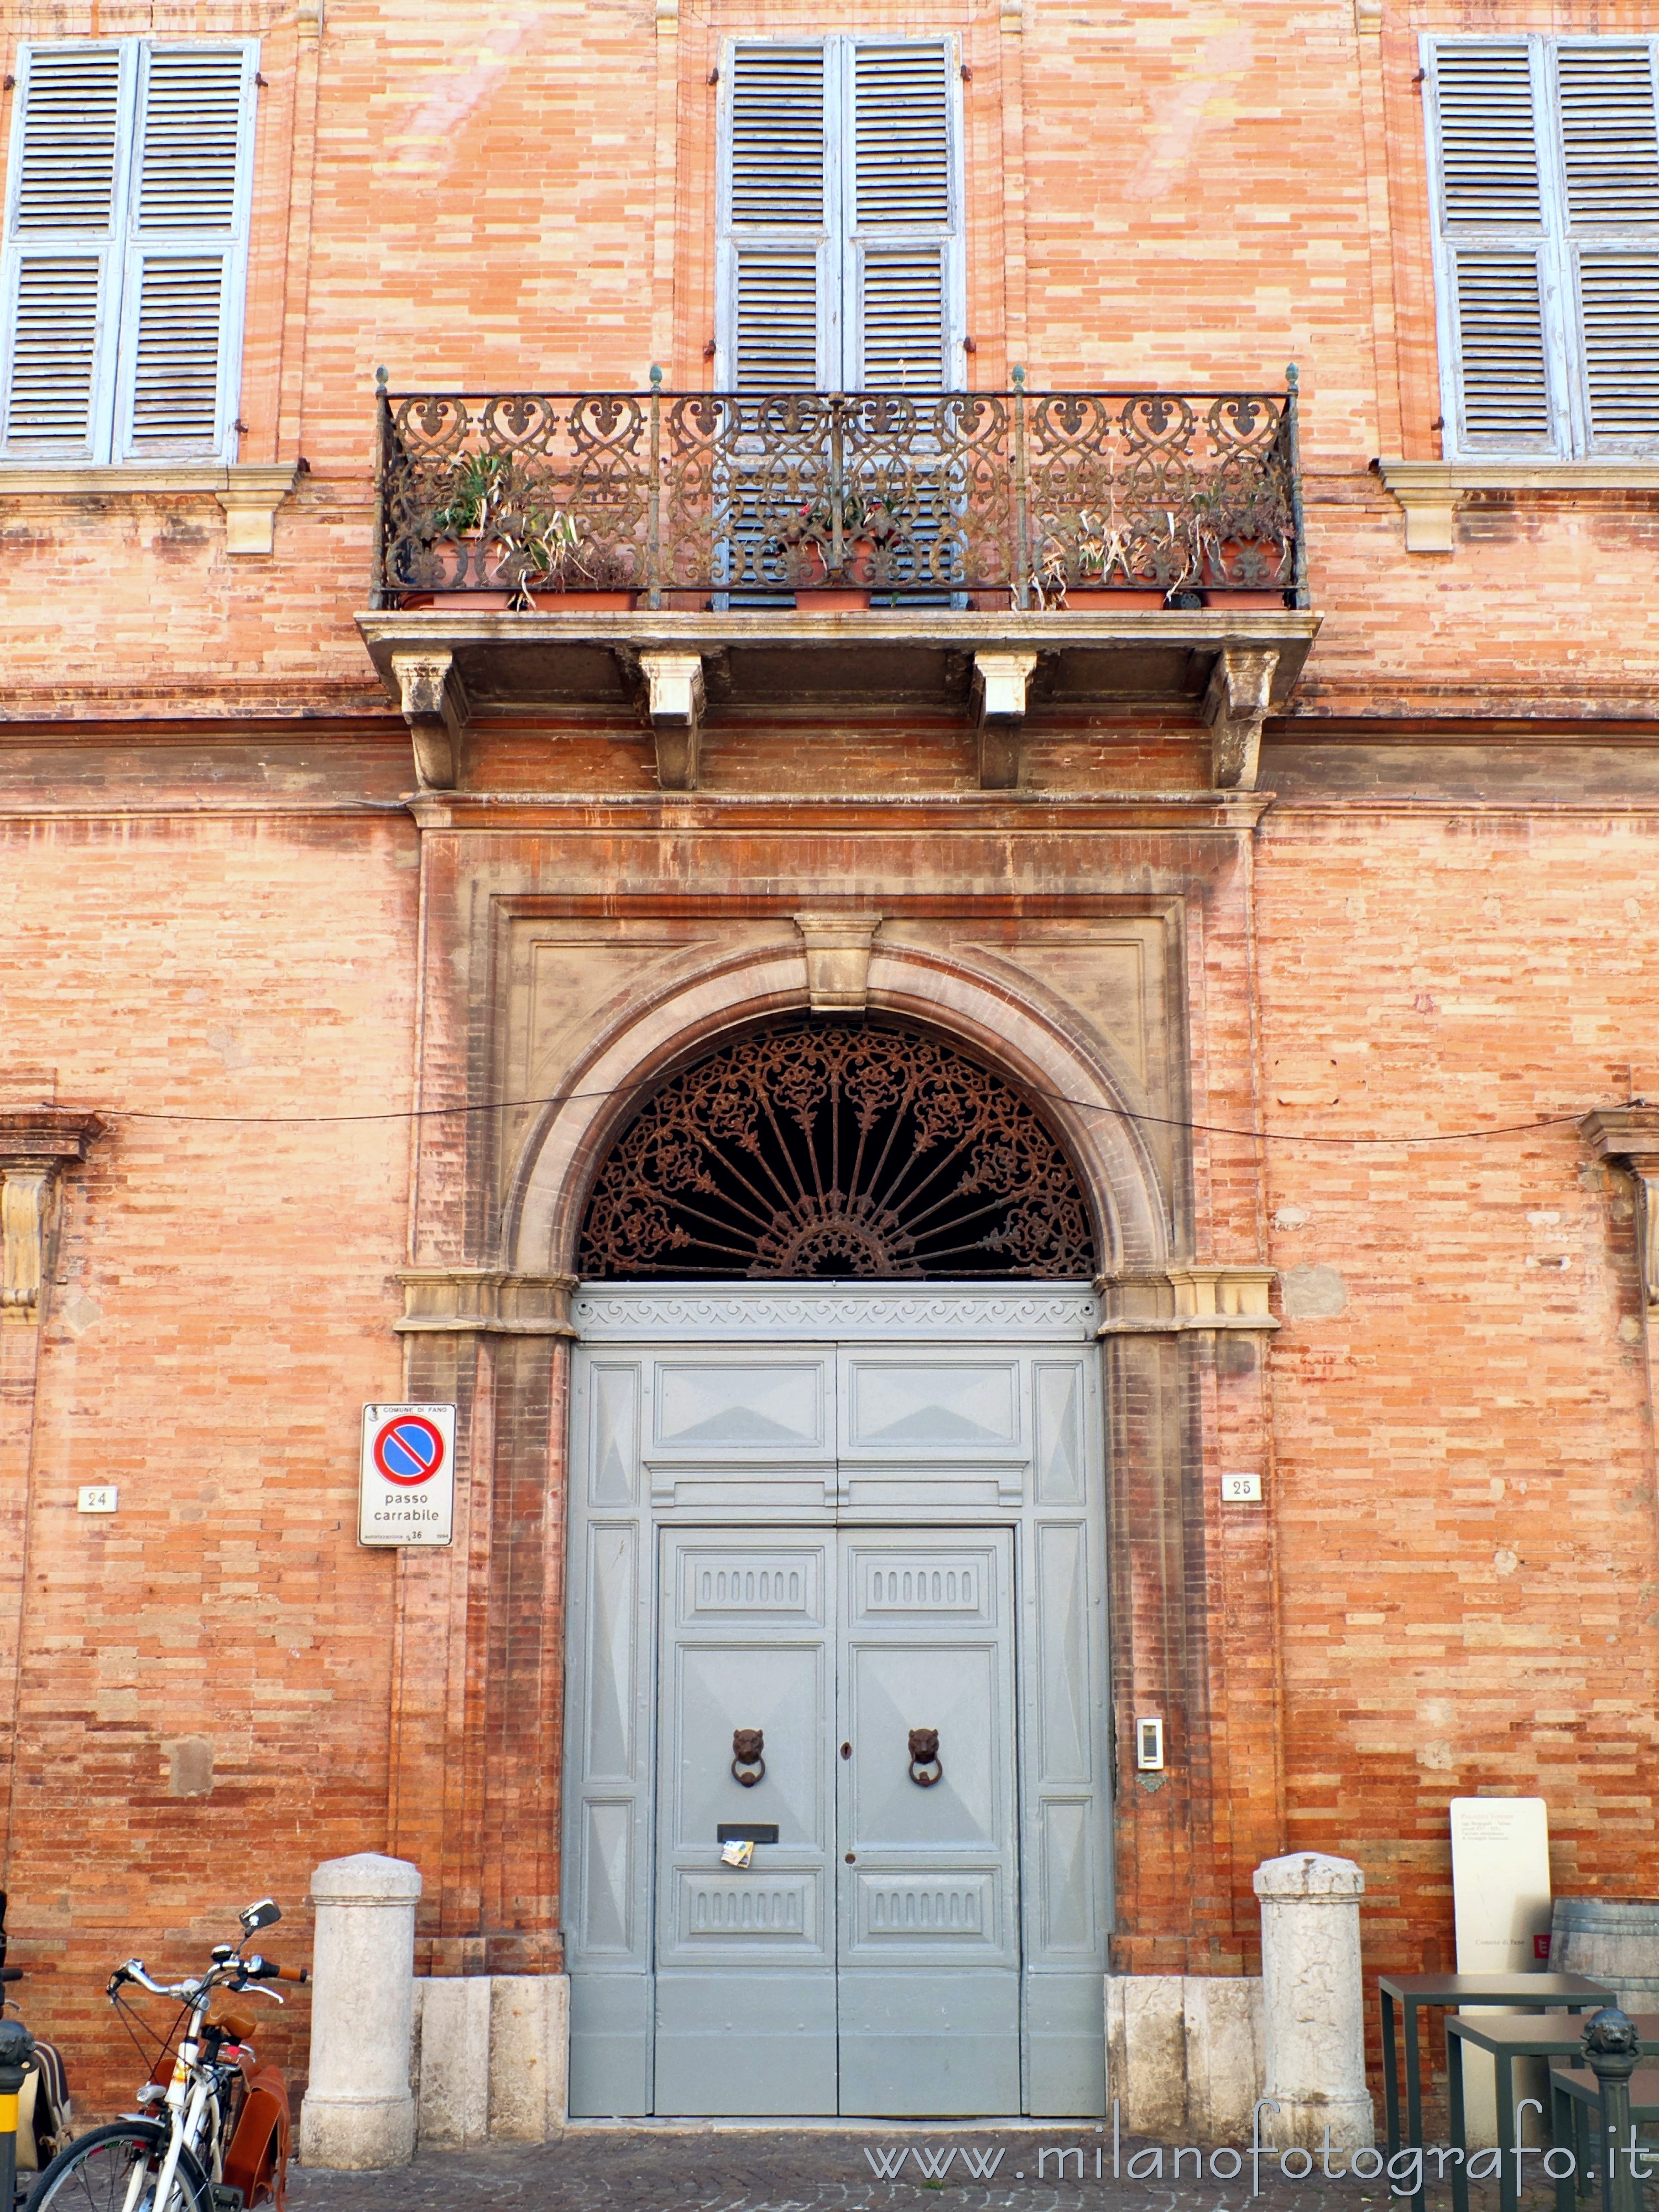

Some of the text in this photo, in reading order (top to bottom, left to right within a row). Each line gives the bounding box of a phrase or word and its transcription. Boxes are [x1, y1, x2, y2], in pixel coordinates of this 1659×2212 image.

[1233, 1481, 1250, 1494] 25
[88, 1492, 106, 1506] 24
[385, 1495, 428, 1506] passo
[374, 1509, 439, 1521] carrabile
[412, 1531, 422, 1539] 36
